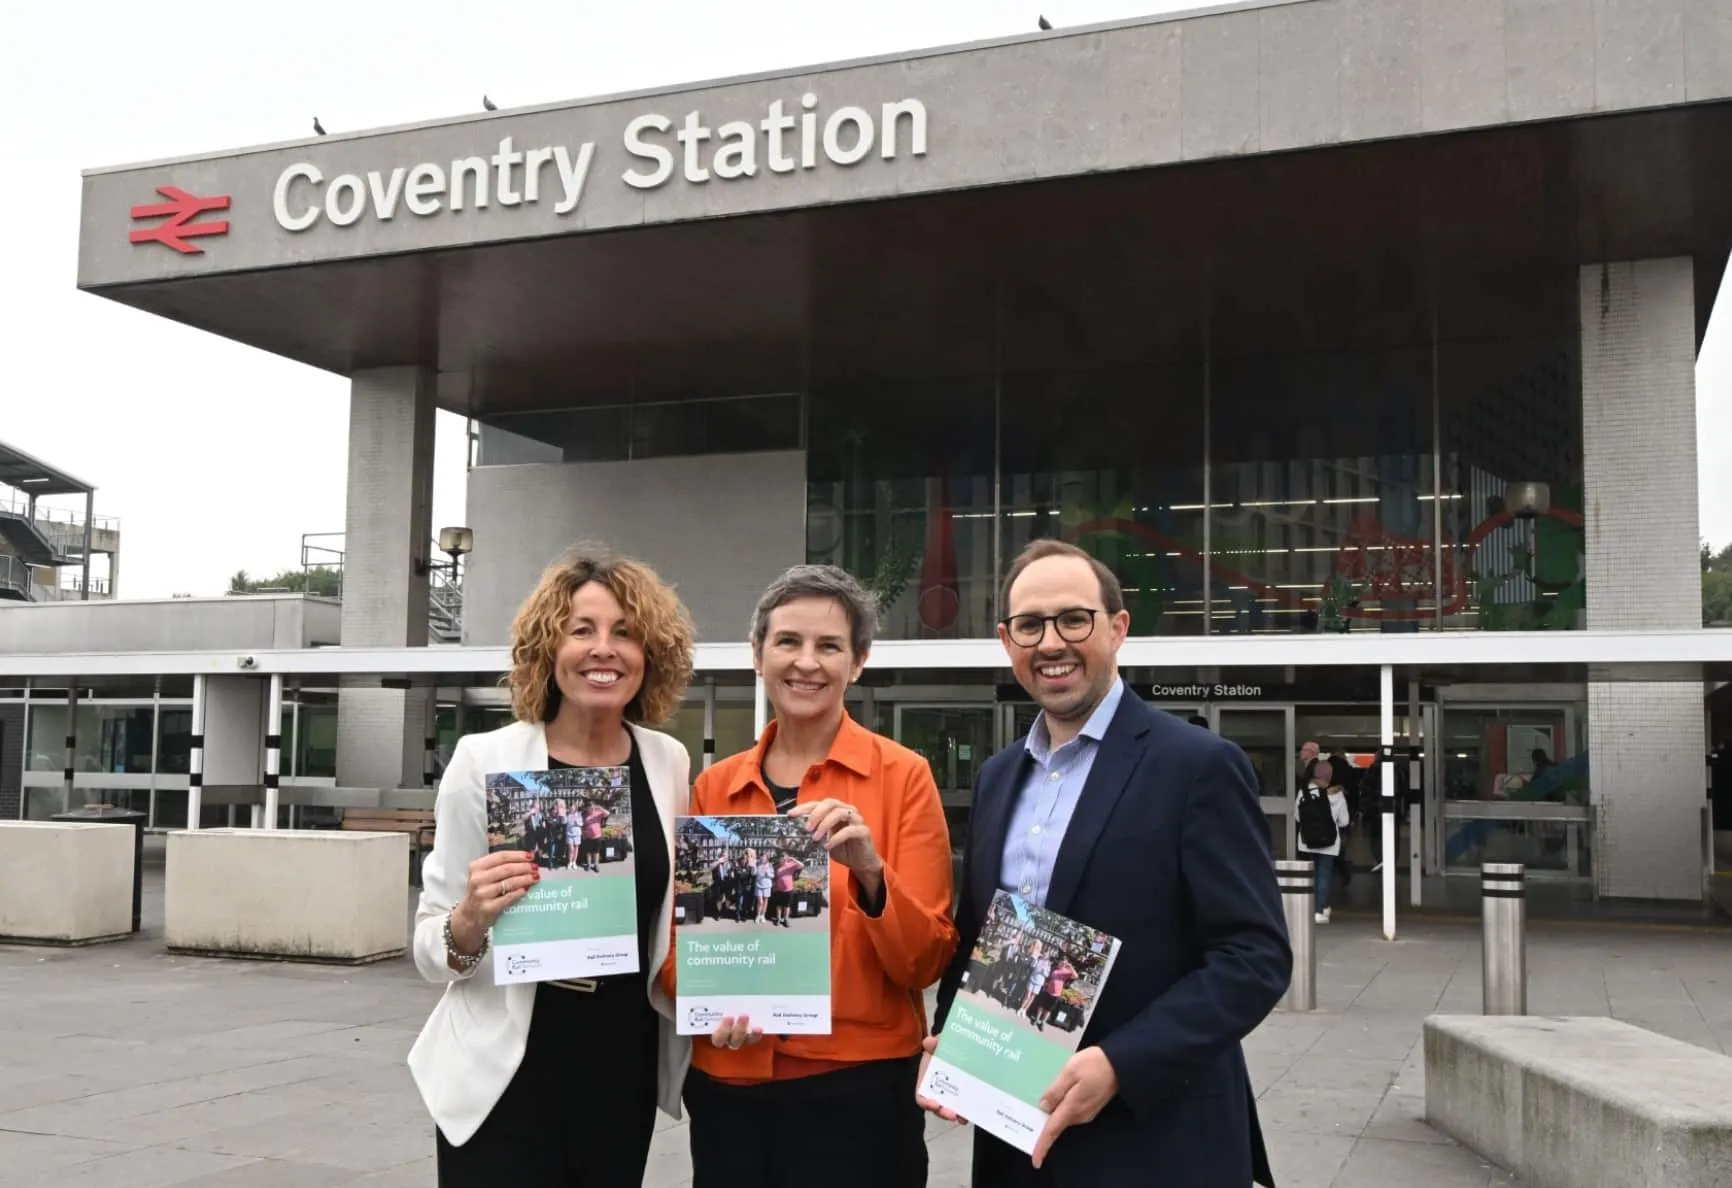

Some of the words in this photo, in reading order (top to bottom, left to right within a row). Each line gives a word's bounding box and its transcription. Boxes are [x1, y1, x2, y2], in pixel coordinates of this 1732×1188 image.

[273, 137, 595, 232] Coventry
[621, 93, 928, 190] Station
[1151, 684, 1210, 698] Coventry
[1213, 684, 1261, 696] Station
[527, 887, 558, 900] value
[560, 885, 573, 898] of
[571, 898, 588, 910] rail
[687, 940, 710, 952] The
[712, 939, 745, 952] value
[747, 939, 760, 952] of
[687, 955, 755, 968] community
[757, 953, 776, 965] rail
[956, 1005, 973, 1025] The
[974, 1018, 999, 1038] value
[1000, 1029, 1014, 1042] of
[950, 1022, 1004, 1056] community
[1003, 1047, 1021, 1062] rail
